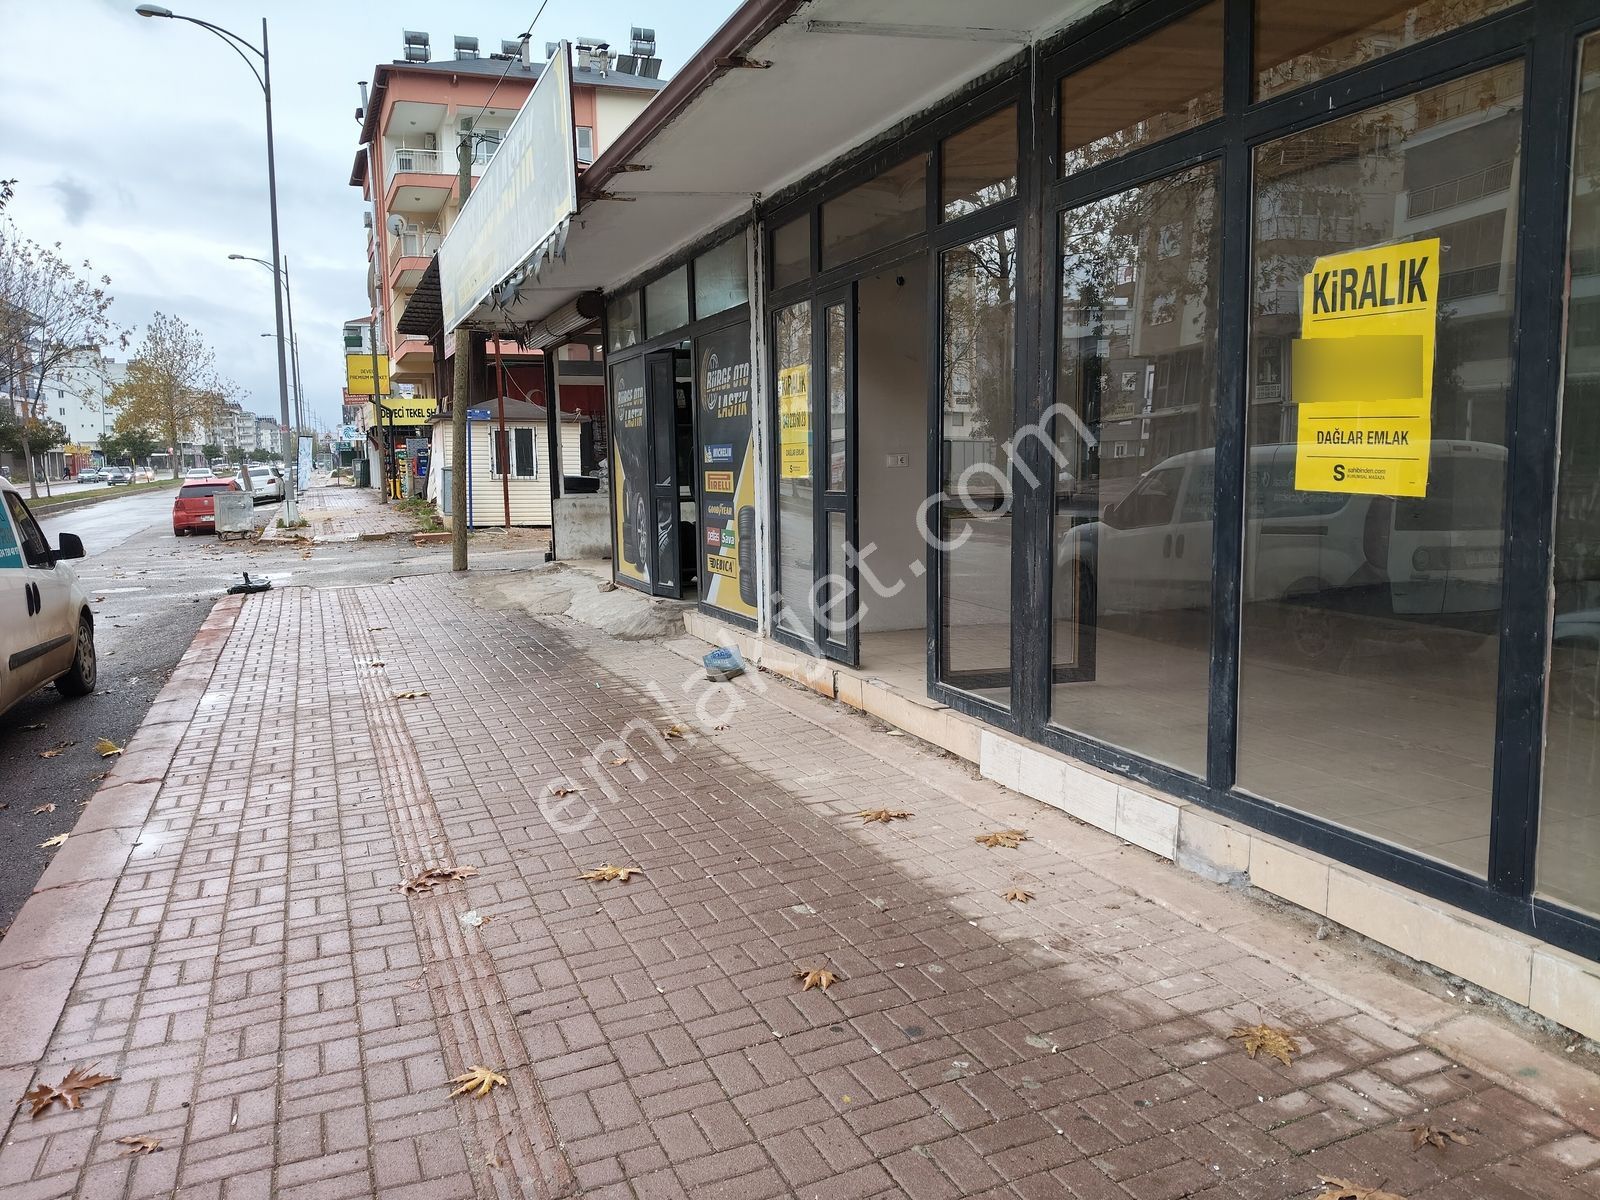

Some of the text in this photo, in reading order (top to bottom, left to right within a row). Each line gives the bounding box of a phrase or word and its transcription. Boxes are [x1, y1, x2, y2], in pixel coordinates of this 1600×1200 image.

[733, 362, 750, 388] OTO
[381, 405, 404, 418] DEECİ
[405, 408, 425, 418] TEKEL
[1316, 428, 1409, 446] DAĞLAR EMLAK
[712, 447, 732, 457] MICHELIN
[708, 474, 731, 491] PIRELLI
[721, 532, 735, 544] Sava
